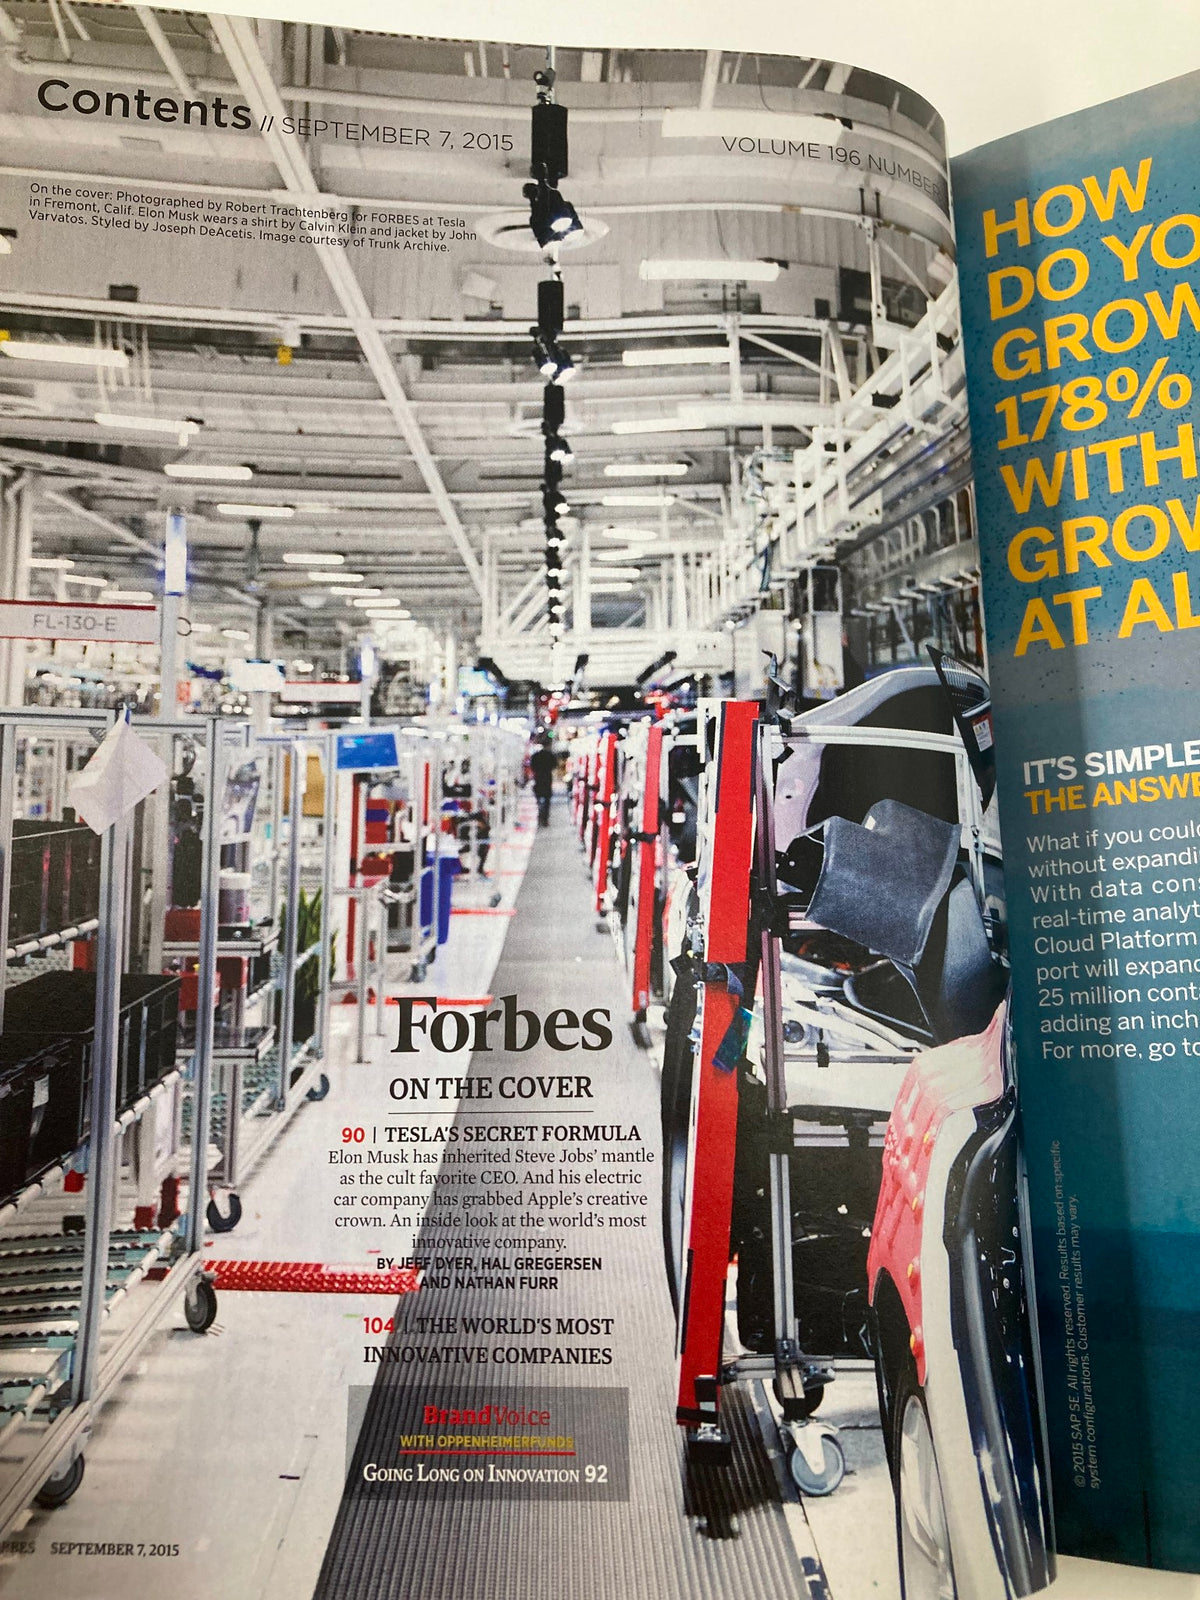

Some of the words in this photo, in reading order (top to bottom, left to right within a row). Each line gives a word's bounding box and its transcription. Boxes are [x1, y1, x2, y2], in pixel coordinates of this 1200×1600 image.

[37, 79, 252, 130] Contents
[282, 117, 430, 148] SEPTEMBER
[439, 130, 455, 151] 7,
[463, 132, 514, 152] 2015
[722, 136, 821, 159] VOLUME
[828, 146, 861, 166] 196
[30, 183, 48, 195] On
[52, 185, 71, 197] the
[75, 189, 113, 201] cover:
[117, 191, 204, 209] Photographed
[208, 199, 222, 212] by
[226, 201, 266, 214] Robert
[271, 205, 348, 222] Trachtenberg
[352, 211, 368, 222] for
[372, 213, 419, 225] FORBES
[423, 217, 433, 226] at
[437, 217, 465, 228] Tesla
[30, 196, 40, 206] in
[45, 198, 100, 213] Fremont,
[105, 203, 134, 216] Calif.
[139, 207, 165, 219] Elon
[169, 209, 199, 222] Musk
[203, 214, 238, 225] wears
[251, 217, 278, 229] shirt
[282, 219, 295, 231] by
[299, 220, 335, 233] Calvin
[339, 224, 367, 235] Klein
[370, 225, 391, 236] and
[394, 227, 429, 239] jacket
[433, 228, 446, 241] by
[449, 230, 477, 241] John
[983, 157, 1152, 258] HOW
[29, 210, 87, 224] Varvatos.
[91, 215, 130, 229] Styled
[135, 219, 148, 231] by
[153, 222, 195, 236] Joseph
[200, 225, 256, 240] DeAcetis.
[259, 230, 296, 243] Image
[299, 235, 349, 248] courtesy
[353, 237, 365, 247] of
[369, 239, 400, 249] Trunk
[404, 240, 450, 252] Archive.
[987, 248, 1089, 321] DO
[1101, 213, 1200, 282] YO
[992, 282, 1200, 381] GROW
[995, 356, 1192, 450] 178%
[1000, 423, 1198, 514] WITH
[33, 613, 117, 632] FL-130-E
[1014, 586, 1103, 657] AT
[1118, 571, 1200, 639] AL
[1023, 756, 1078, 785] IT'S
[1085, 739, 1200, 777] SIMPLE
[1024, 785, 1086, 815] THE
[1026, 831, 1080, 853] What
[1086, 829, 1098, 847] if
[1104, 830, 1142, 850] you
[1028, 855, 1106, 878] without
[1030, 884, 1081, 903] With
[1090, 879, 1142, 898] data
[1033, 908, 1126, 929] real-time
[1034, 934, 1094, 954] Cloud
[1101, 930, 1197, 950] Platform
[1036, 962, 1080, 985] port
[1085, 959, 1119, 978] will
[1038, 988, 1064, 1007] 25
[1070, 986, 1141, 1006] million
[390, 994, 613, 1053] Forbes
[1040, 1013, 1112, 1035] adding
[1118, 1015, 1144, 1030] an
[1151, 1010, 1198, 1029] inch
[1042, 1041, 1074, 1060] For
[1081, 1043, 1143, 1059] more,
[1149, 1043, 1176, 1062] go
[389, 1078, 430, 1100] ON
[436, 1077, 492, 1099] THE
[499, 1075, 594, 1099] COVER
[342, 1127, 365, 1143] 90
[385, 1126, 459, 1142] TESLA'S
[463, 1126, 538, 1142] SECRET
[542, 1125, 641, 1141] FORMULA
[328, 1150, 362, 1164] Elon
[367, 1149, 409, 1164] Musk
[413, 1149, 438, 1164] has
[442, 1148, 511, 1164] inherited
[515, 1149, 555, 1163] Steve
[602, 1147, 655, 1163] mantle
[340, 1174, 355, 1185] as
[359, 1170, 383, 1185] the
[387, 1170, 416, 1185] cult
[419, 1170, 476, 1185] favorite
[480, 1170, 518, 1184] CEO.
[523, 1170, 554, 1184] And
[558, 1170, 581, 1184] his
[585, 1169, 642, 1184] electric
[334, 1194, 358, 1206] car
[361, 1194, 430, 1209] company
[433, 1191, 458, 1206] has
[462, 1191, 523, 1209] grabbed
[587, 1191, 648, 1205] creative
[1069, 1194, 1079, 1221] vary.
[334, 1215, 386, 1227] crown.
[390, 1213, 411, 1227] An
[416, 1212, 461, 1227] inside
[465, 1212, 498, 1227] look
[502, 1213, 516, 1227] at
[520, 1212, 544, 1227] the
[608, 1213, 647, 1227] most
[1055, 1201, 1066, 1236] based
[412, 1234, 490, 1249] innovative
[495, 1238, 567, 1252] company.
[377, 1258, 394, 1270] BY
[397, 1257, 431, 1270] JEFF
[435, 1258, 477, 1272] DYER,
[481, 1258, 511, 1270] HAL
[514, 1257, 602, 1270] GREGERSEN
[1058, 1237, 1069, 1280] Results
[1071, 1250, 1083, 1289] results
[419, 1277, 450, 1289] AND
[455, 1277, 515, 1289] NATHAN
[520, 1277, 558, 1290] FURR
[1062, 1283, 1073, 1335] reserved.
[1075, 1291, 1088, 1350] Customer
[363, 1317, 395, 1334] 104
[417, 1318, 457, 1334] THE
[462, 1317, 551, 1335] WORLD'S
[556, 1318, 614, 1335] MOST
[364, 1347, 488, 1364] INNOVATIVE
[493, 1347, 613, 1365] COMPANIES
[1065, 1338, 1078, 1372] rights
[1067, 1375, 1079, 1390] All
[1081, 1353, 1096, 1441] configurations.
[1069, 1413, 1083, 1441] SAP
[400, 1435, 434, 1447] WITH
[1072, 1442, 1085, 1473] 2015
[1088, 1445, 1102, 1489] system
[585, 1465, 608, 1483] 92
[50, 1542, 134, 1556] SEPTEMBER
[149, 1544, 179, 1557] 2015
